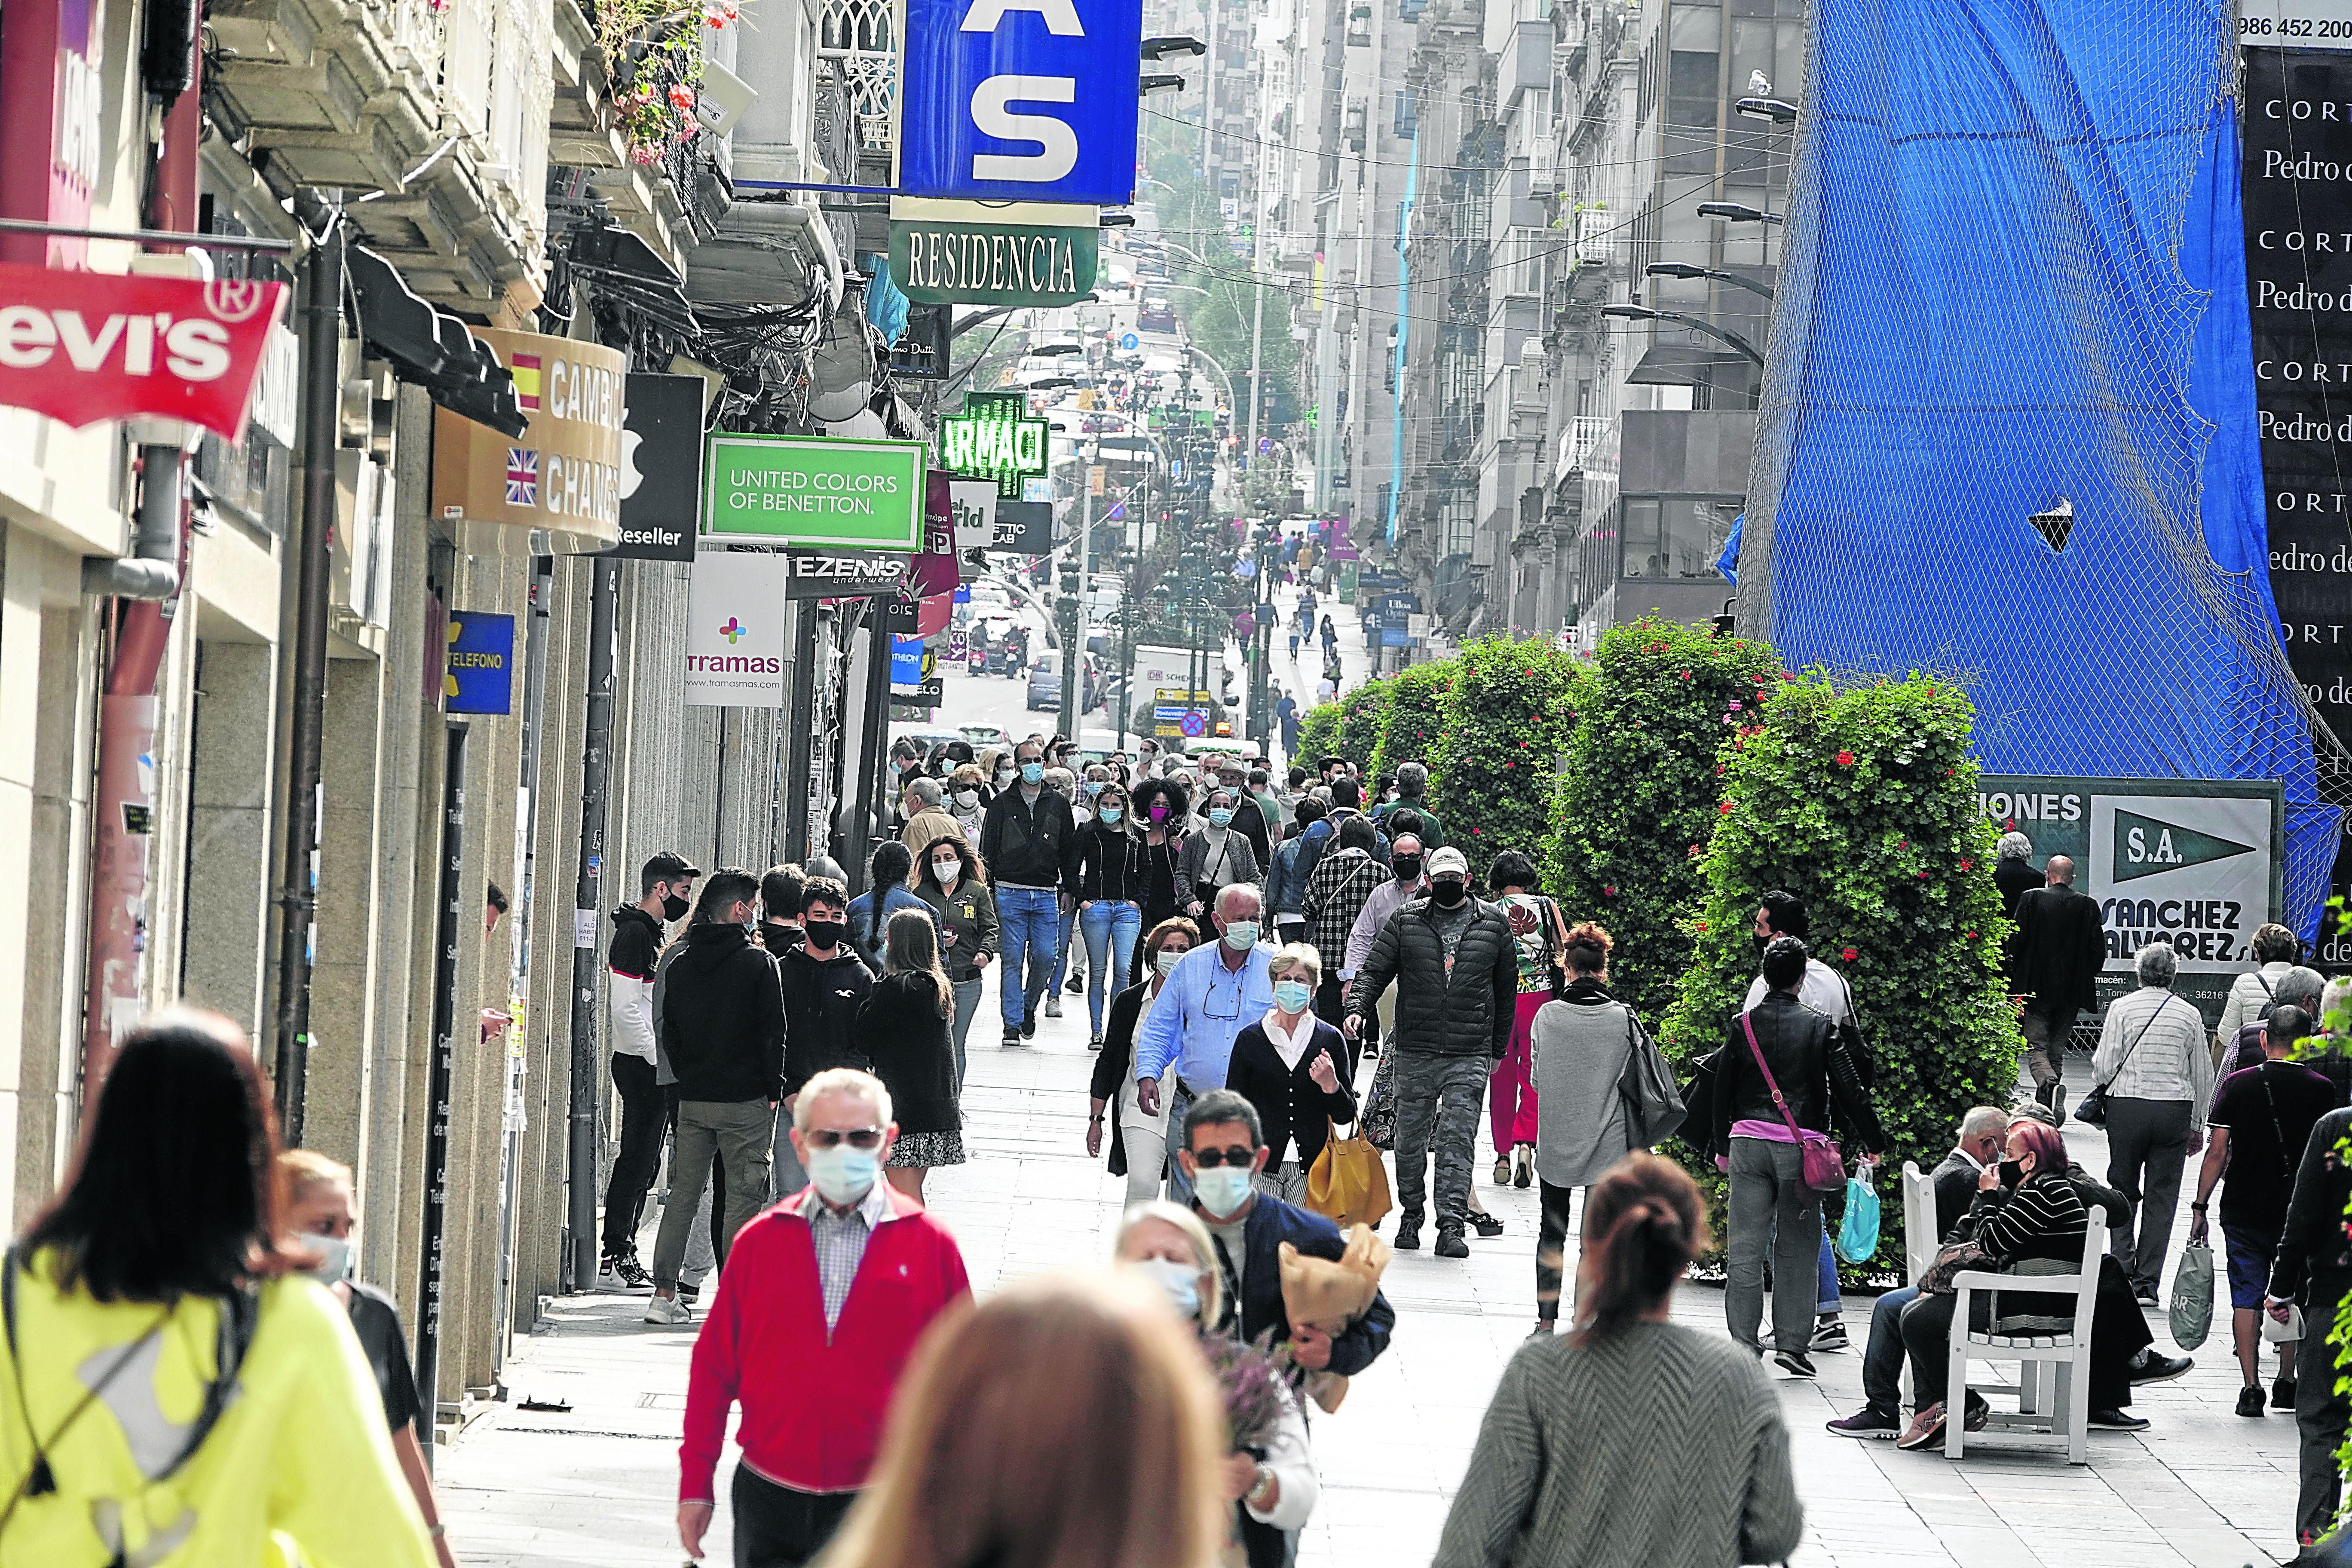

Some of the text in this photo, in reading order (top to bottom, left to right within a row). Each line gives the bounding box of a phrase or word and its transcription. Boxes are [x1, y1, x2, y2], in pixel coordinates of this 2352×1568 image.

[2240, 18, 2352, 38] 986 452 200
[2262, 150, 2339, 181] Pedro
[908, 232, 1078, 294] RESIDENCIA
[2256, 280, 2333, 312] Pedro
[910, 343, 935, 354] Dutti
[2258, 410, 2332, 442] Pedro
[731, 470, 898, 493] UNITED COLORS
[729, 491, 874, 515] OF BENETTON.
[617, 526, 682, 546] Reseller
[2269, 543, 2326, 572] edro
[833, 576, 898, 584] underwear
[447, 652, 502, 669] TELEFONO
[2127, 827, 2183, 863] S.A.
[2095, 975, 2126, 984] macén:
[2195, 990, 2223, 999] 36216
